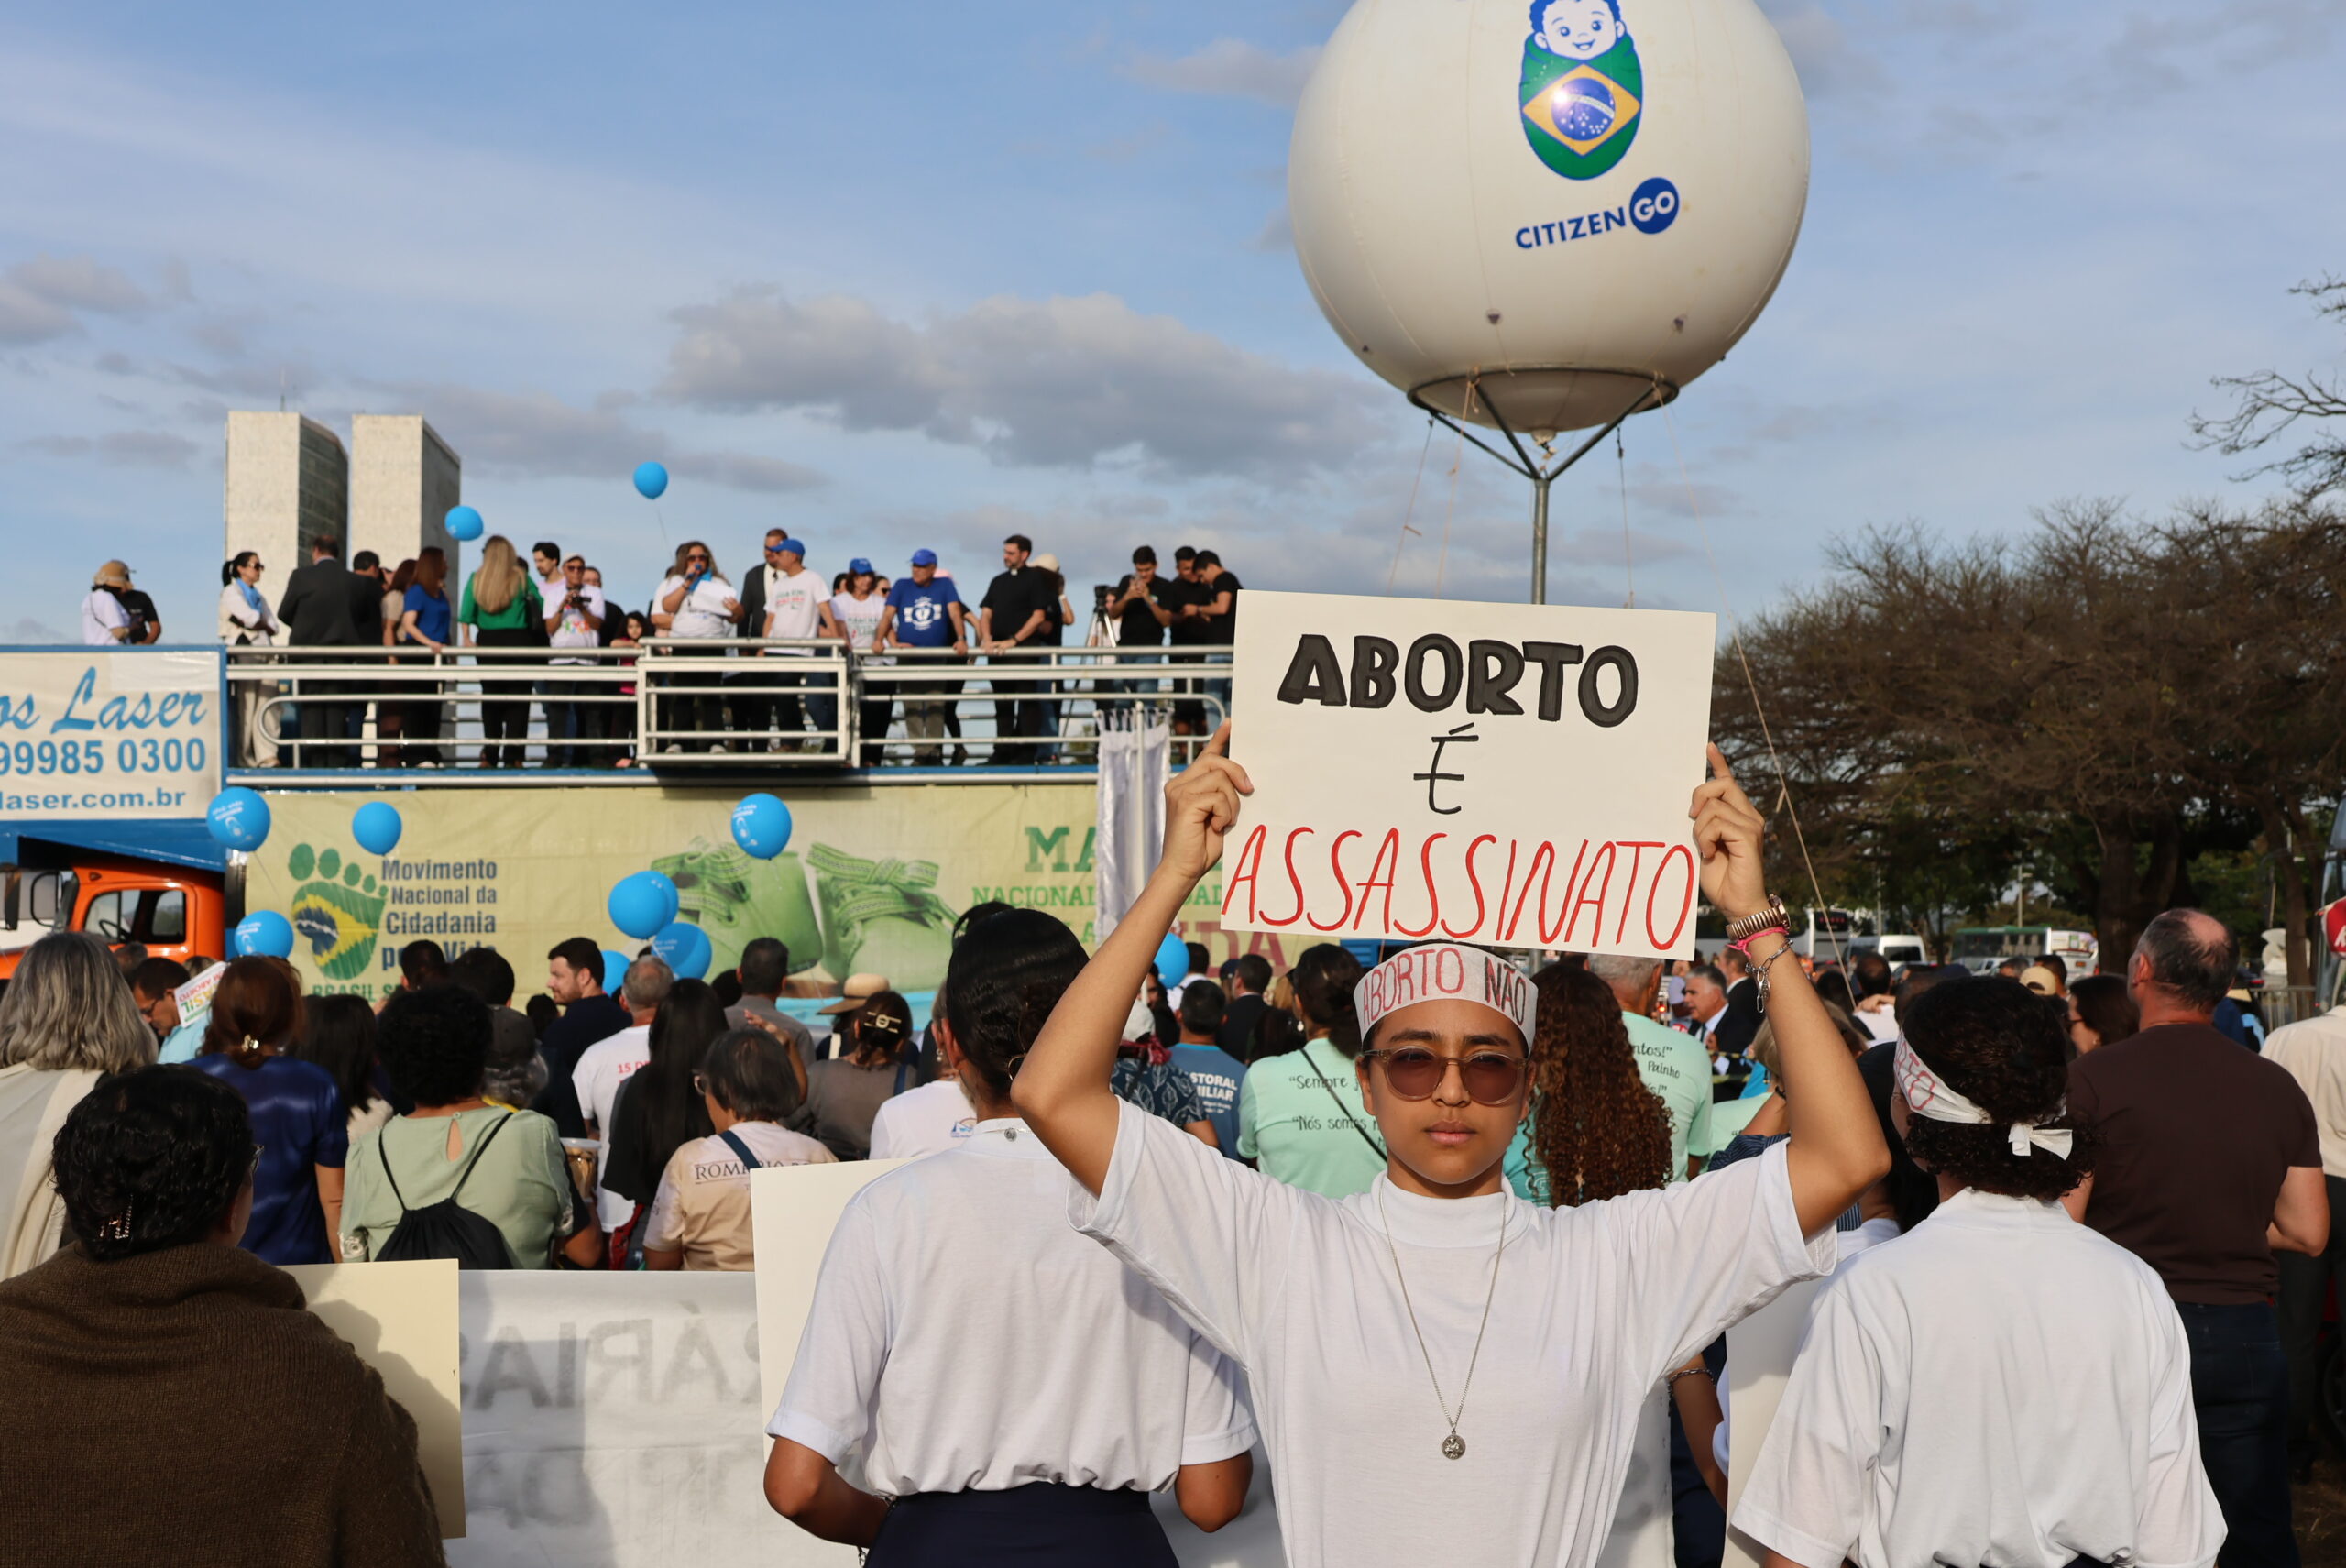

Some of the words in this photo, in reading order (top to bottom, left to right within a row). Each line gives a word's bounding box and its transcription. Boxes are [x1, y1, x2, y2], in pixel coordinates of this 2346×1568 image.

[1277, 633, 1639, 728] ABORTO
[50, 666, 207, 735] Laser
[117, 738, 206, 773] 0300
[1413, 722, 1479, 815] É
[381, 860, 498, 881] Movimento
[391, 886, 470, 905] Nacional
[477, 886, 497, 904] da
[1222, 824, 1694, 951] ASSASSINATO
[386, 910, 496, 935] Cidadania
[1363, 947, 1464, 1031] ABORTO
[1484, 955, 1527, 1026] NÃO
[618, 1062, 631, 1073] 15
[1184, 1070, 1238, 1091] STORAL
[1648, 1060, 1681, 1080] Painho
